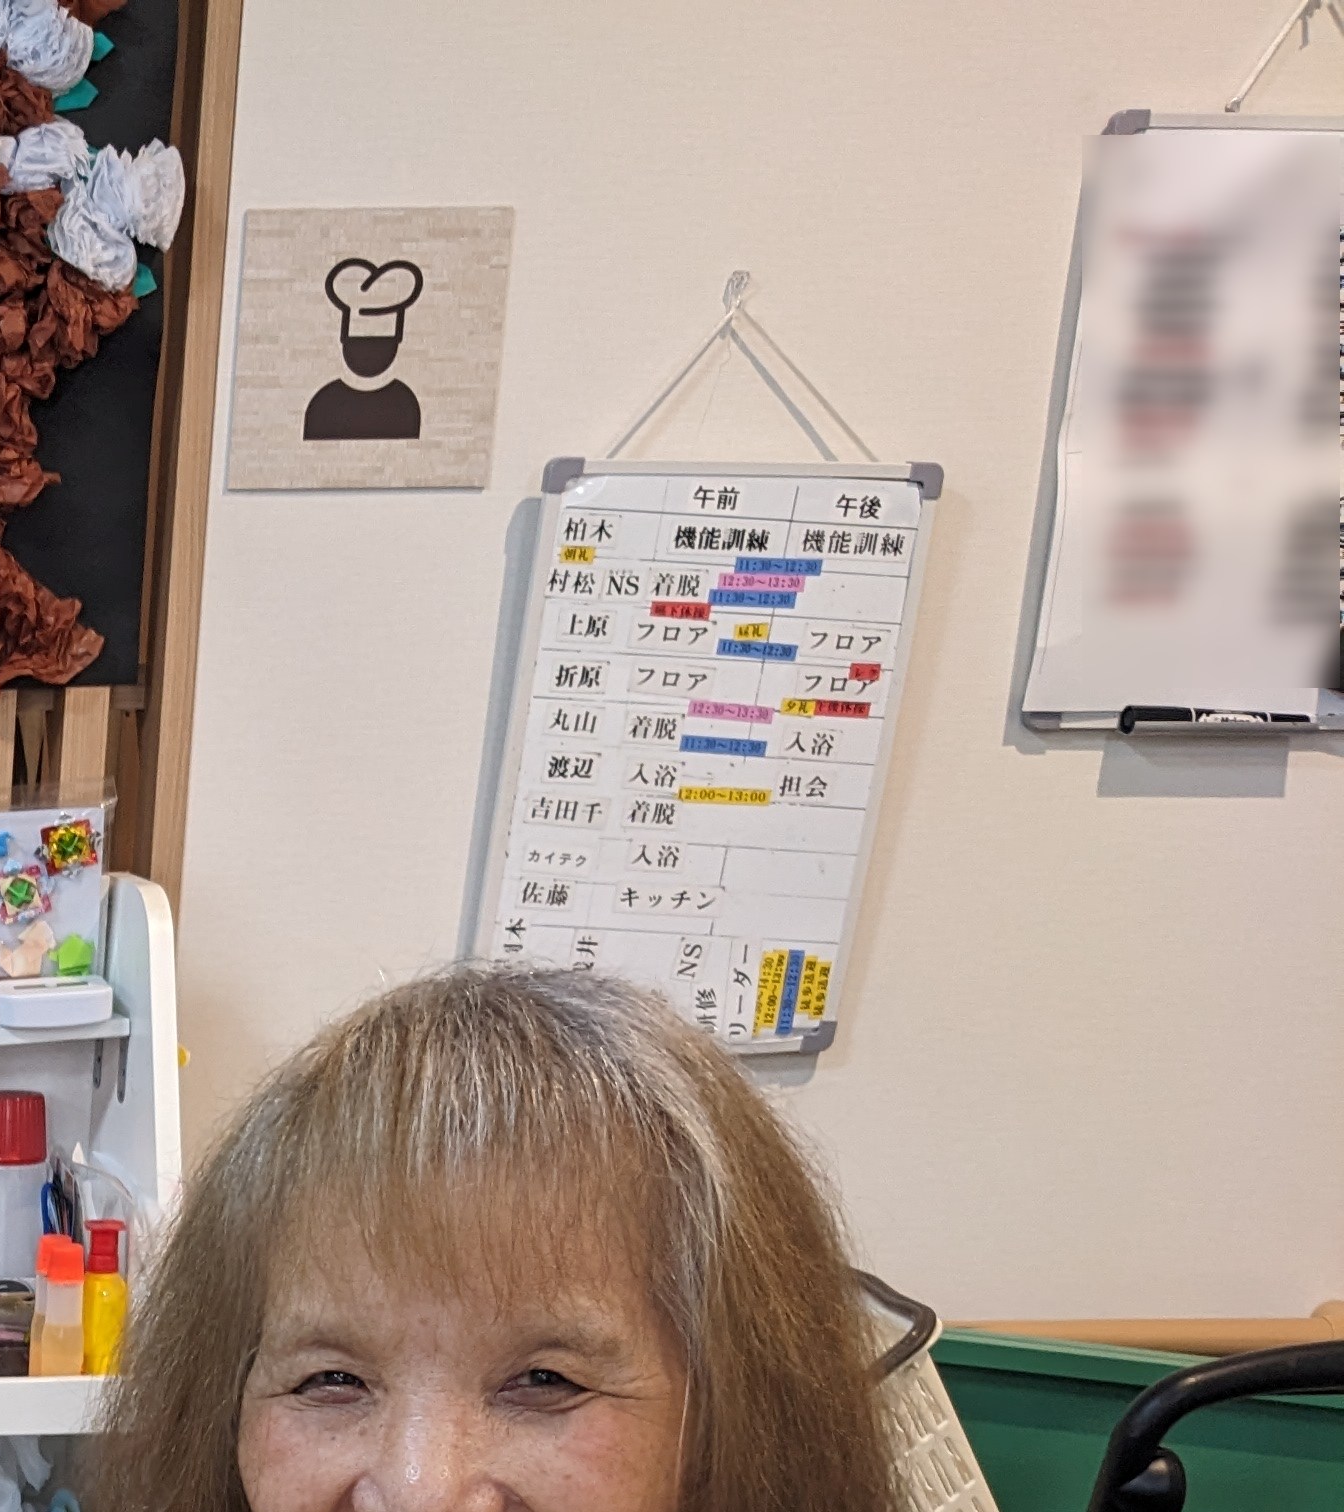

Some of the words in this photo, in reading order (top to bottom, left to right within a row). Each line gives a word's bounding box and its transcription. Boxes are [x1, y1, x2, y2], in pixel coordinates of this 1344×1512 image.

[694, 487, 742, 511] 午前
[835, 494, 882, 518] 午後
[563, 517, 614, 541] 柏木
[674, 526, 770, 552] 機能訓練
[802, 530, 905, 556] 機能訓練
[548, 568, 596, 595] 村松
[606, 574, 641, 596] NS
[652, 573, 701, 598] 着脱
[568, 613, 610, 638] 上原
[638, 623, 709, 645] フロア
[810, 631, 882, 653] フロア
[556, 664, 603, 688] 折原
[637, 667, 709, 691] フロア
[548, 709, 597, 735] 丸山
[628, 716, 677, 741] 着脱
[785, 732, 835, 757] 入浴
[547, 755, 594, 780] 渡辺
[629, 763, 677, 788] 入浴
[779, 777, 828, 799] 担会
[530, 798, 603, 823] 吉田千
[627, 801, 675, 826] 着脱
[527, 849, 588, 867] カイテク
[631, 844, 680, 869] 入浴
[521, 883, 570, 907] 佐藤
[619, 887, 718, 911] キッチン
[677, 943, 703, 978] NS
[728, 944, 753, 1036] リーダー
